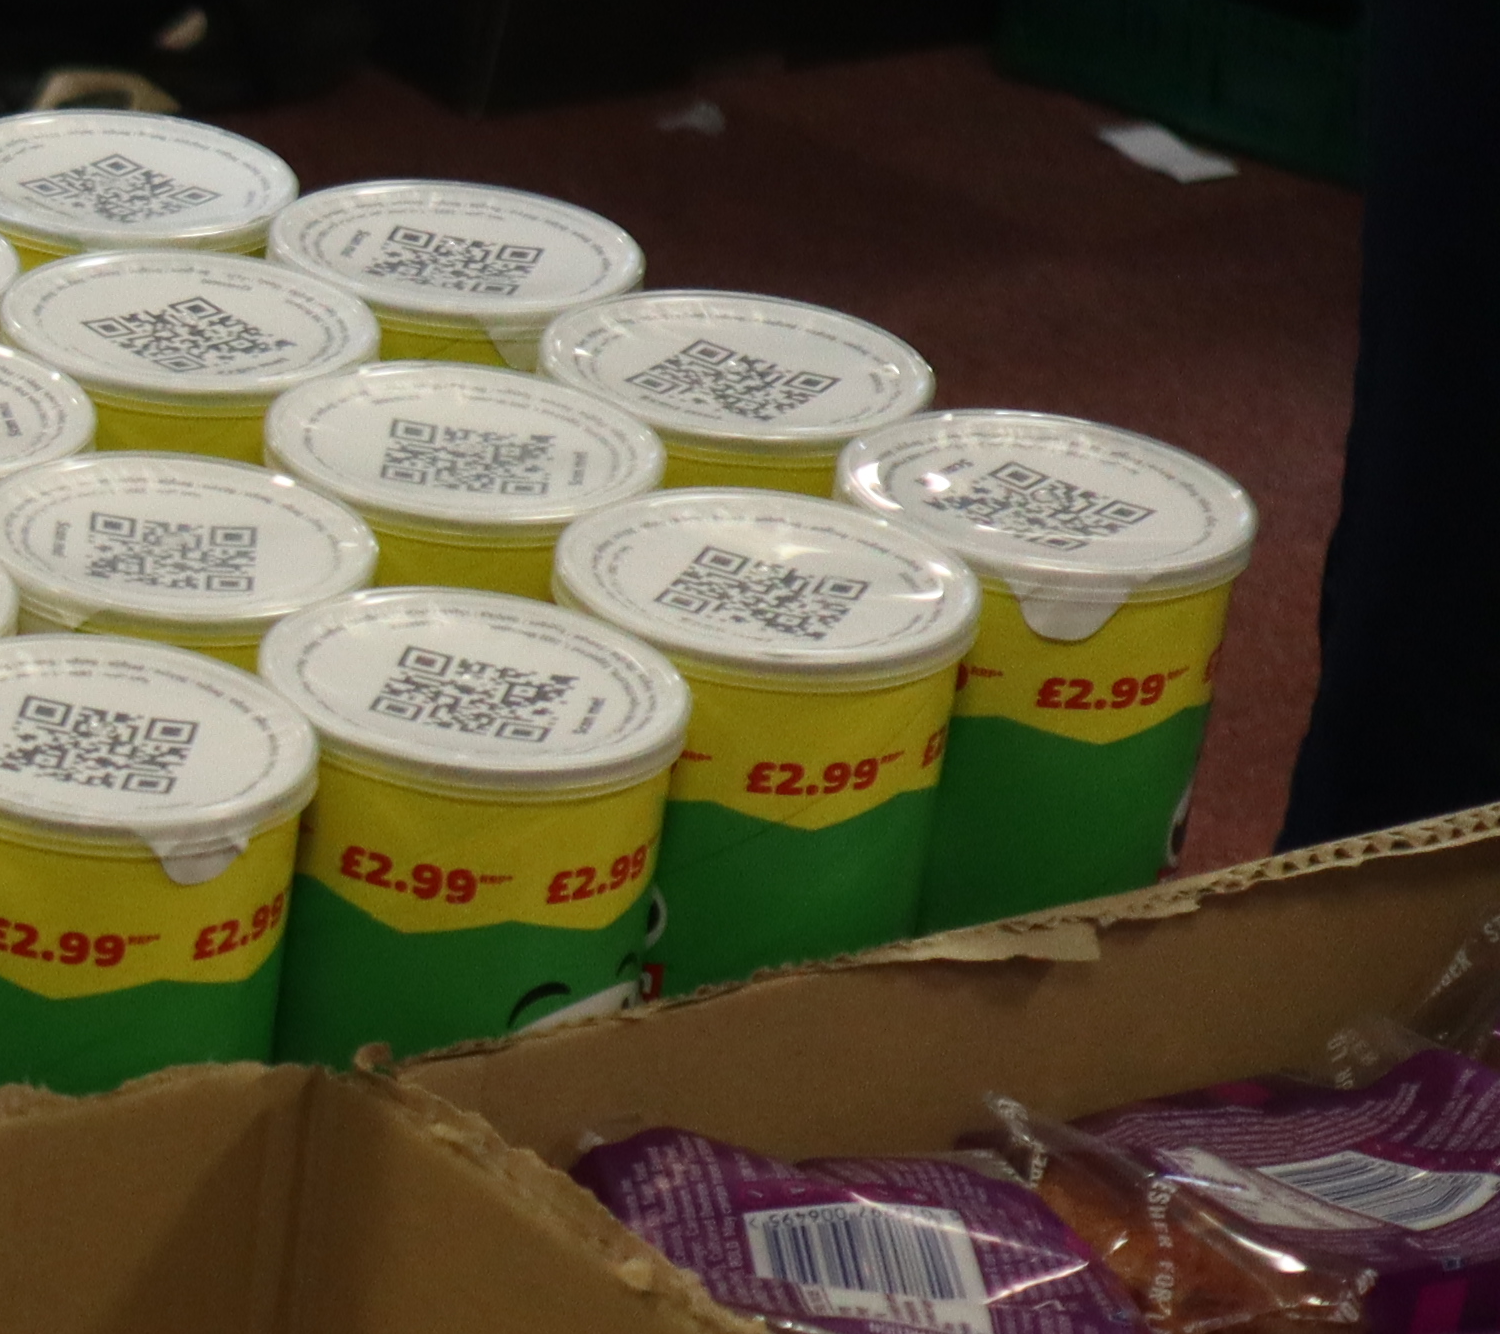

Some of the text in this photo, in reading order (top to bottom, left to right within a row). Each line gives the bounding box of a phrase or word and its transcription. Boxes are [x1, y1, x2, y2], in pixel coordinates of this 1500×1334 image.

[1036, 673, 1166, 711] £2.99
[747, 761, 880, 797] £2.99
[341, 845, 479, 905] £2.99
[545, 843, 649, 906] £2.99
